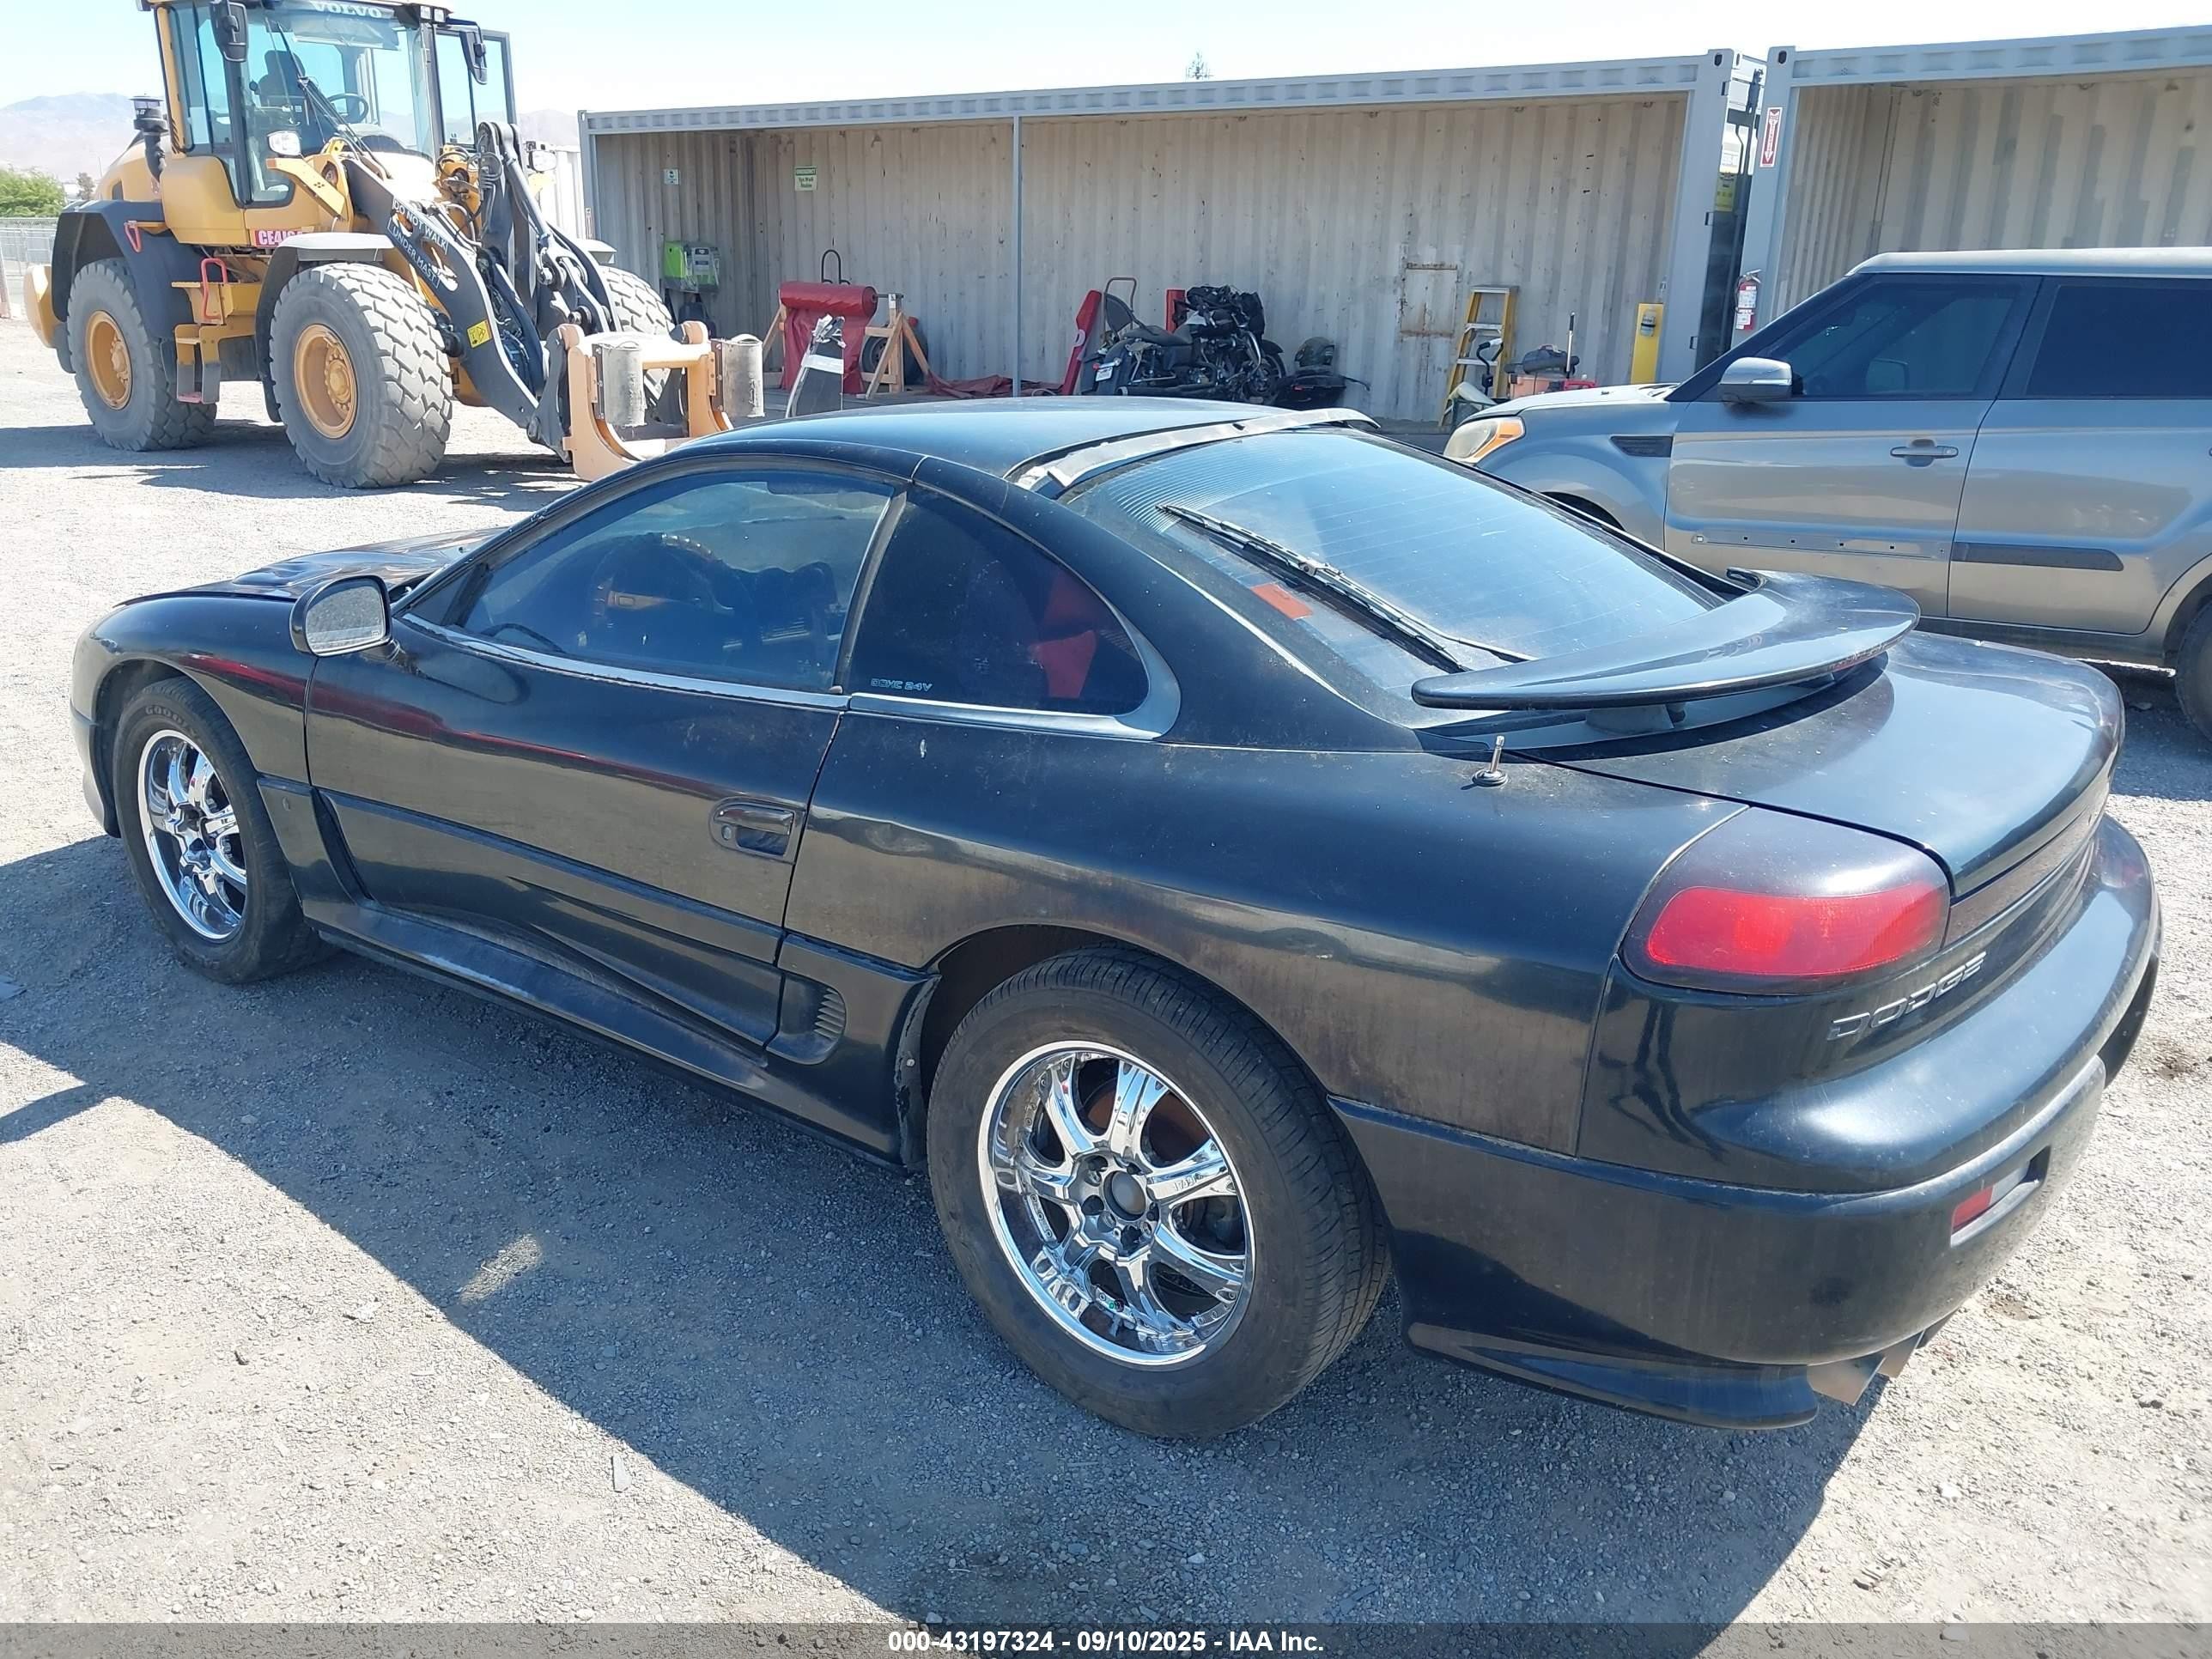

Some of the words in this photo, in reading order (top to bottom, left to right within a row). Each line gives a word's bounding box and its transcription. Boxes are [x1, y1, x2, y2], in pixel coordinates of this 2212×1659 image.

[310, 1, 383, 18] VOLVO
[394, 200, 405, 215] DO
[406, 212, 424, 230] NOT
[424, 225, 447, 250] WALK
[392, 226, 416, 259] UNDER
[416, 256, 437, 282] MAST
[904, 681, 933, 692] 24V
[1826, 951, 1987, 1042] DODGE
